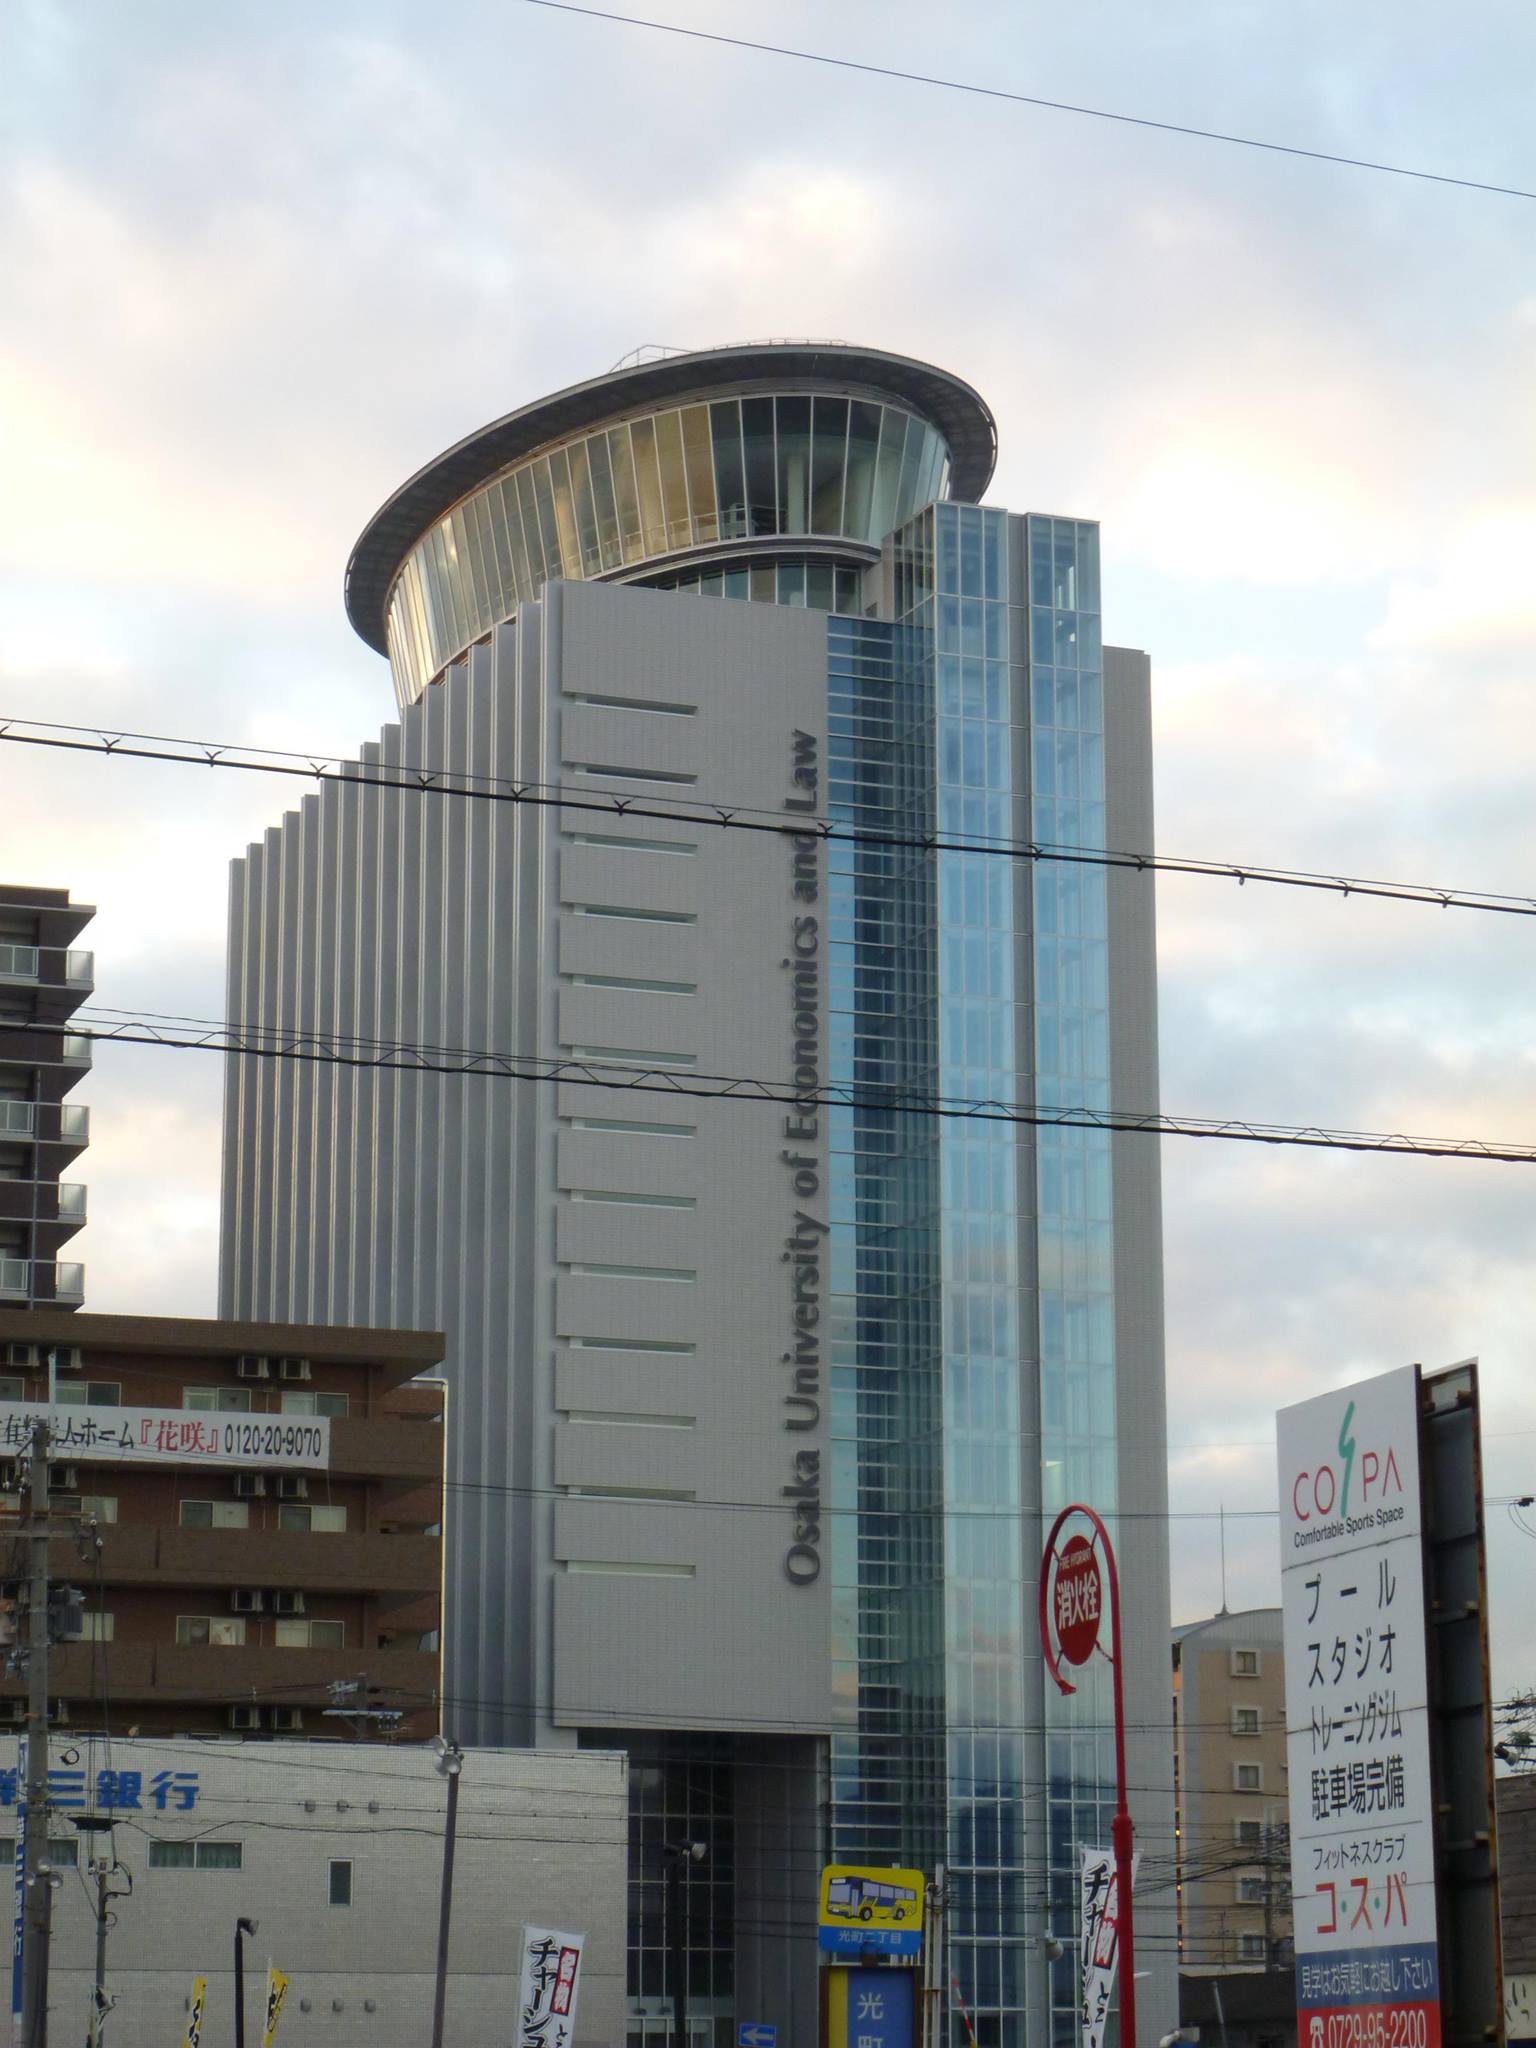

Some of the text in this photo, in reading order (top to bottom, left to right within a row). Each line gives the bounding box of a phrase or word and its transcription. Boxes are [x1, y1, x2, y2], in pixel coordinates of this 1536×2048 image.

[780, 728, 830, 1586] Osaka University of Economics and Law
[1294, 1506, 1405, 1549] Comfortable Sports Space
[1057, 1570, 1099, 1631] 消火栓
[1305, 1558, 1396, 1625] プール
[1308, 1624, 1396, 1688] スタジオ
[1311, 1690, 1403, 1755] トレーニングジム
[1311, 1754, 1405, 1821] 駐車場完備
[1313, 1834, 1406, 1871] フィットネスクラブ
[838, 1929, 902, 1945] 光町二丁目
[1301, 1957, 1433, 1999] 見学はお気軽にお越し下さい
[1328, 2009, 1427, 2048] 0729-95-2200
